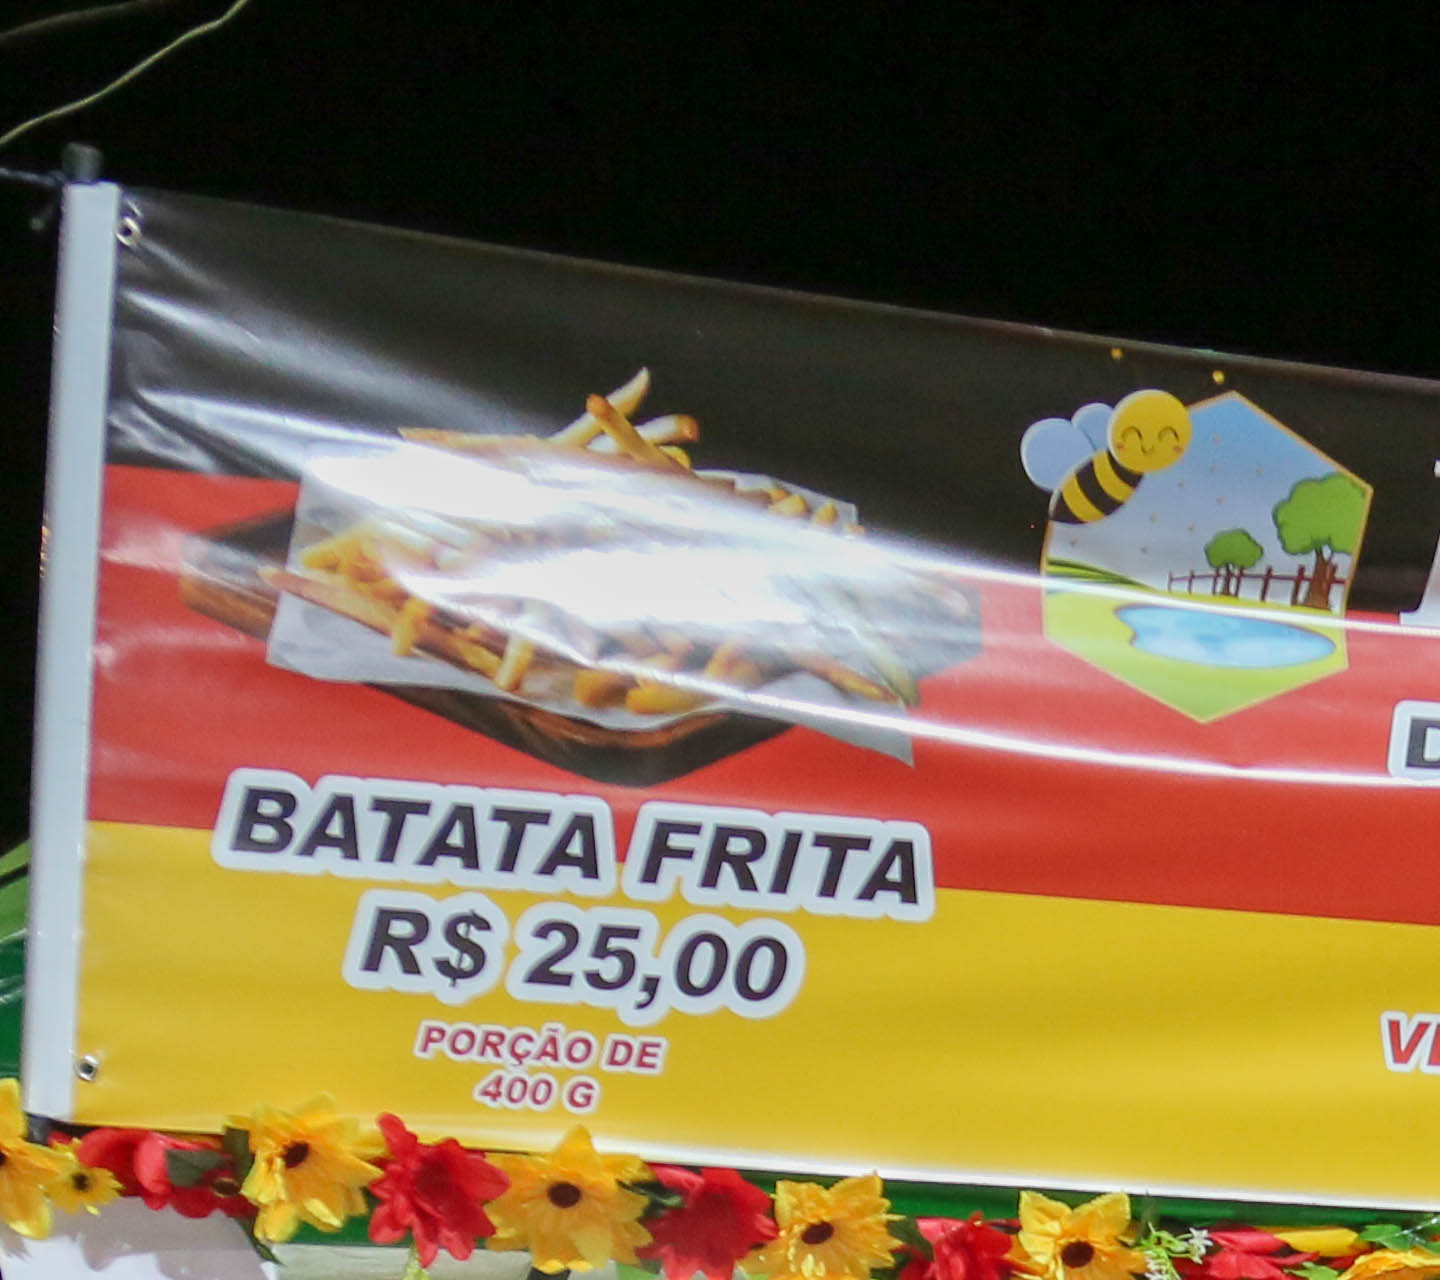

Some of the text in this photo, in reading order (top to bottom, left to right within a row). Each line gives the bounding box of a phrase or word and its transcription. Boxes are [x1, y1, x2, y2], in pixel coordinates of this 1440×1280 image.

[229, 786, 922, 906] BATATA FRITA
[362, 907, 790, 1011] R$ 25,00
[420, 1025, 662, 1075] PORÇÃO DE
[479, 1075, 595, 1109] 400 G
